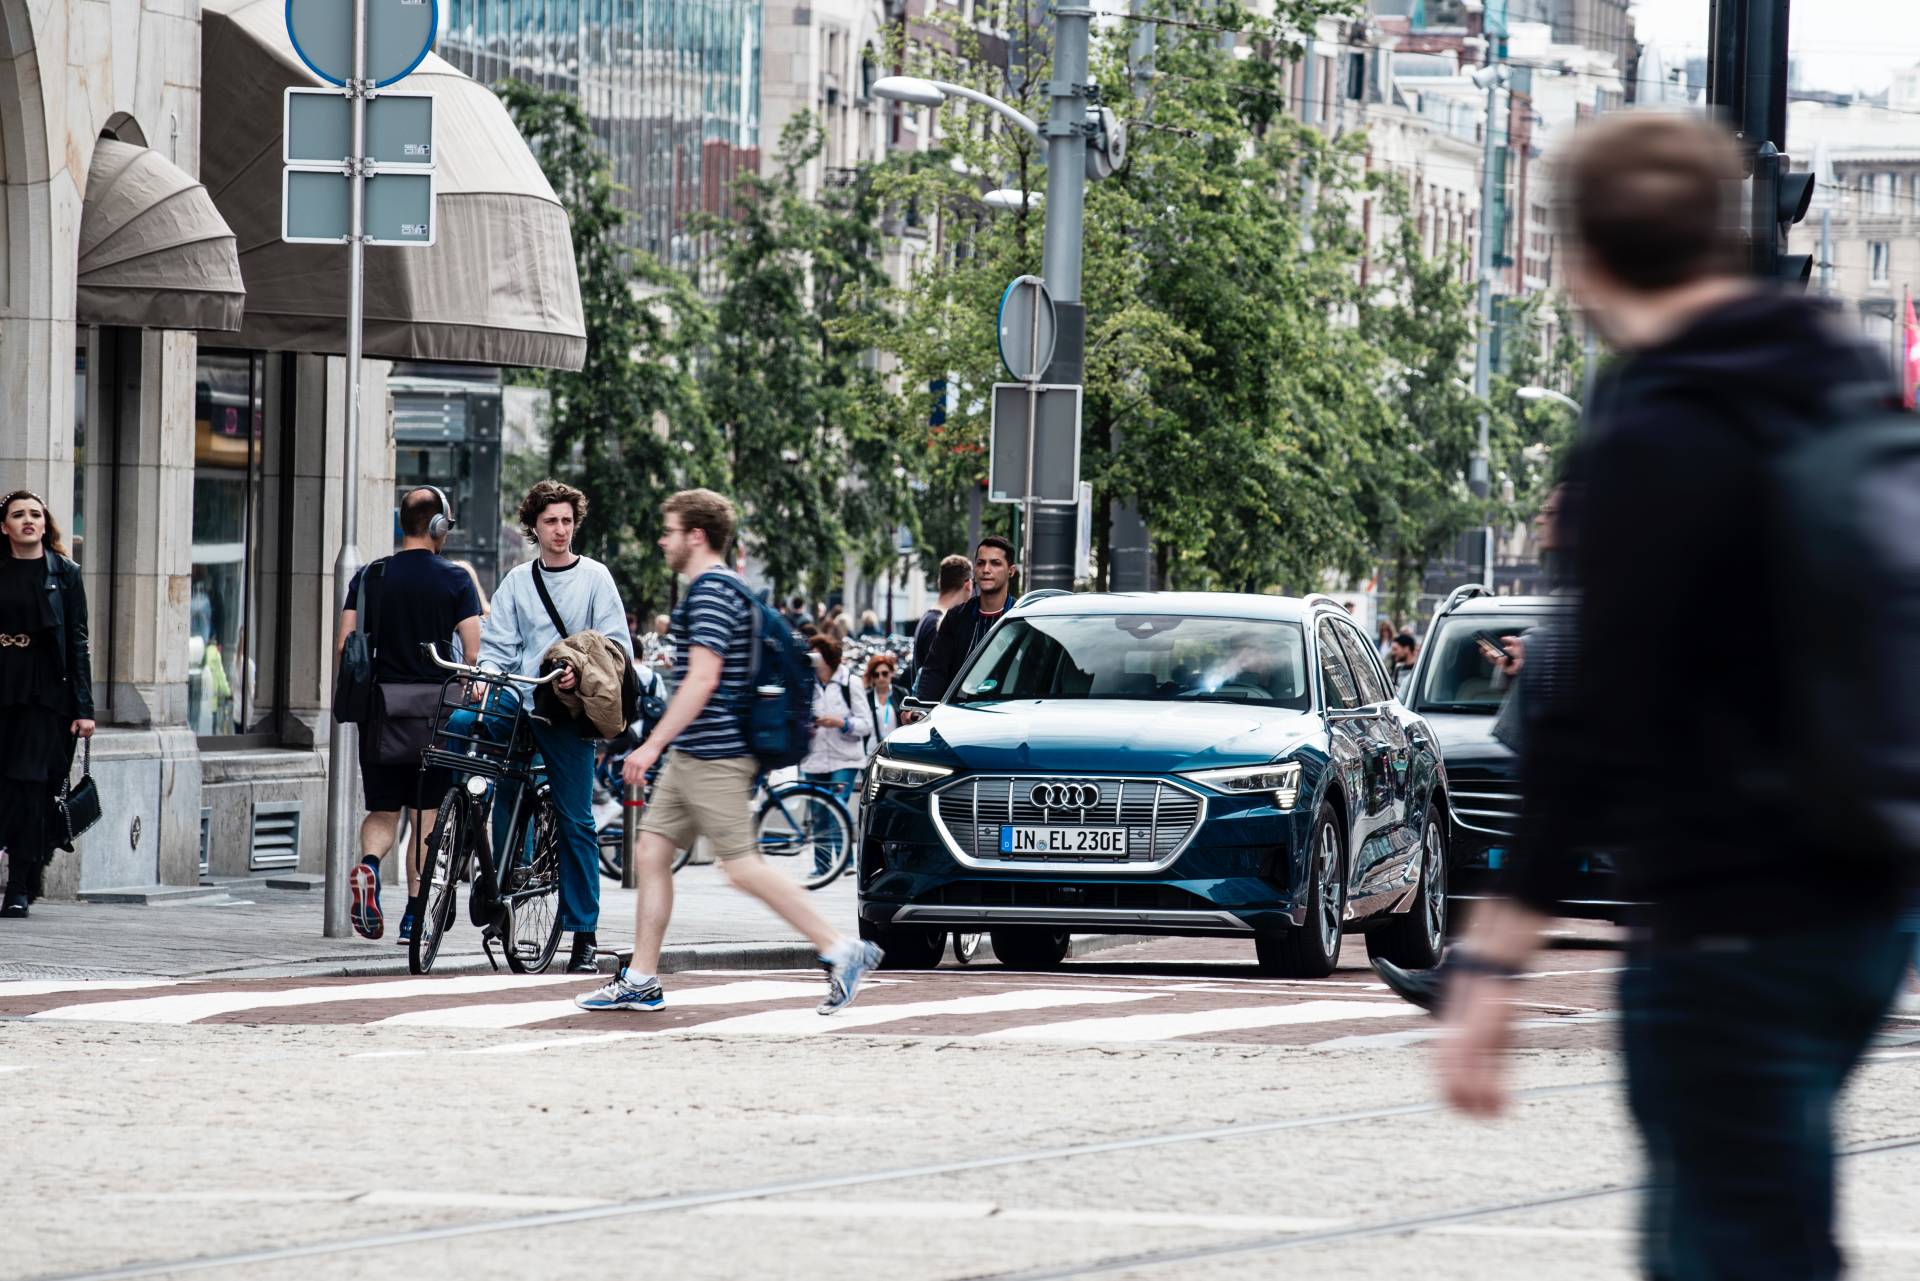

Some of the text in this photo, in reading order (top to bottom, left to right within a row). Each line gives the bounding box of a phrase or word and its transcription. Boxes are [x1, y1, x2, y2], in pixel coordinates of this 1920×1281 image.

[1014, 830, 1123, 851] IN EL 230E
